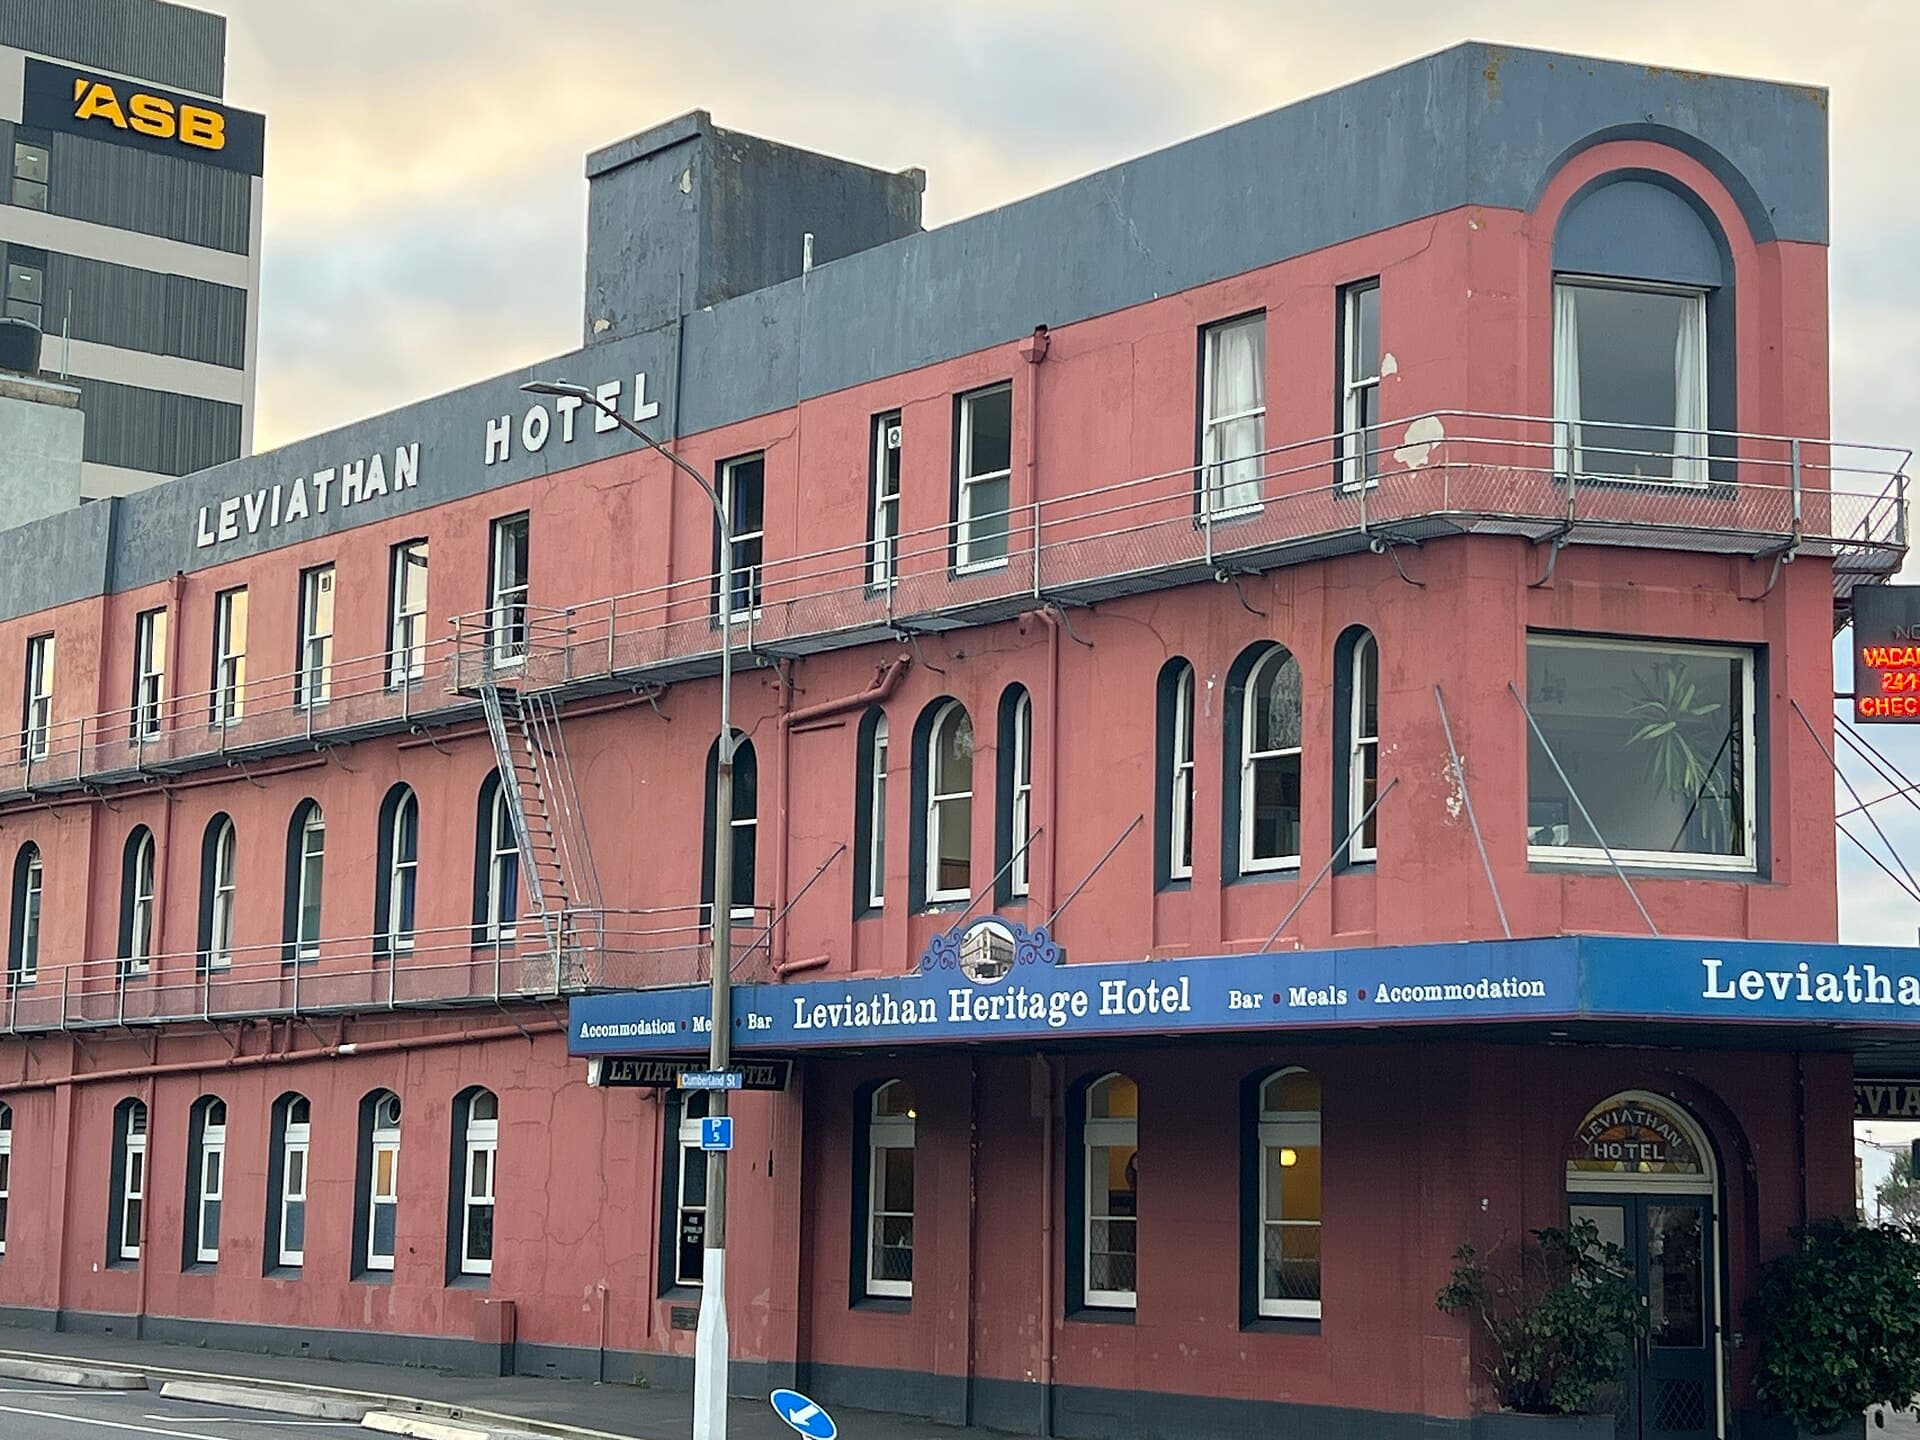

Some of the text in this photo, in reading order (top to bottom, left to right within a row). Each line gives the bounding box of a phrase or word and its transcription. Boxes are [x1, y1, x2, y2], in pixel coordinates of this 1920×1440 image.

[75, 79, 226, 150] ASB
[196, 372, 659, 548] LEVIATHAN HOTEL
[1229, 976, 1546, 1010] Bar Meals Accommodation
[1702, 959, 1920, 1006] Leviatha
[793, 976, 1191, 1030] Leviathan Heritage Hotel
[580, 1019, 676, 1039] Accommodation
[748, 1013, 772, 1030] Bar
[682, 1073, 736, 1087] Cumberland St
[711, 1119, 722, 1132] P
[713, 1131, 721, 1142] 5
[1580, 1109, 1682, 1148] LEVIATHAN
[1593, 1143, 1665, 1160] HOTEL
